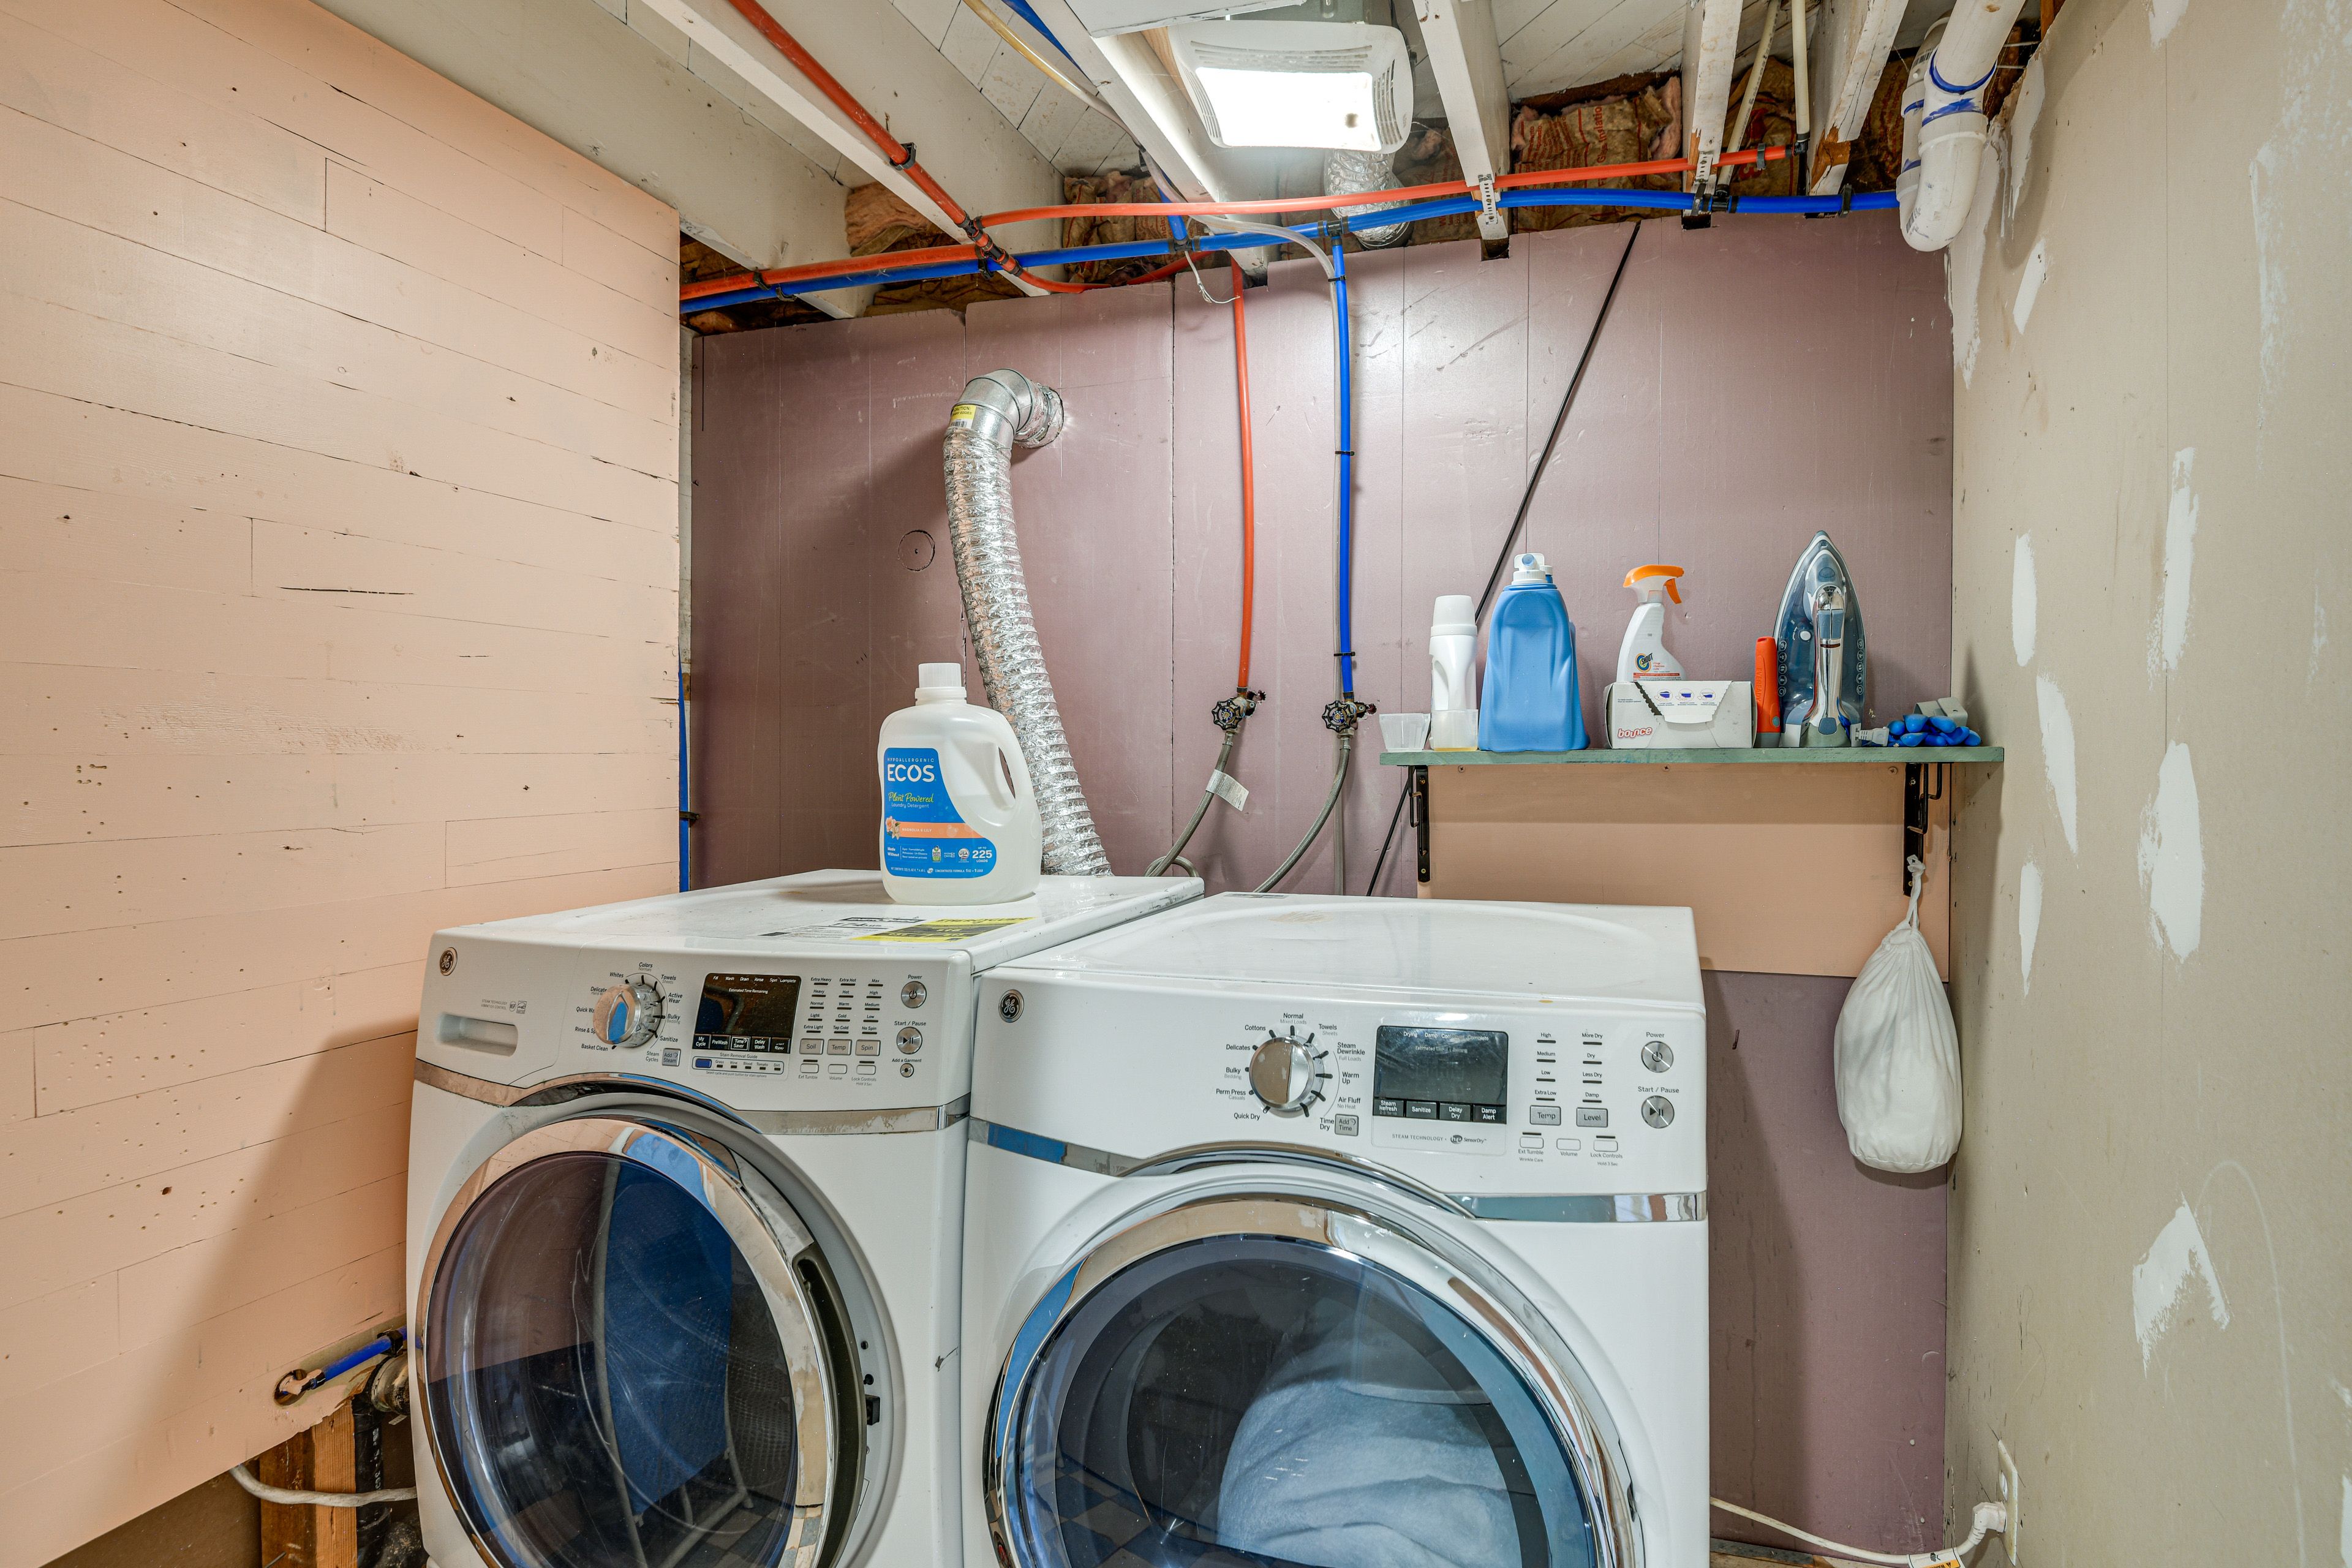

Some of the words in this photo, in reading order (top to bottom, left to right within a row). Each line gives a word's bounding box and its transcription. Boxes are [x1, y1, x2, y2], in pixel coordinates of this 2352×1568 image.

[1642, 653, 1653, 665] SHOUT
[1618, 727, 1653, 739] bounce
[888, 764, 935, 782] ECOS
[888, 791, 904, 802] Plant
[905, 793, 934, 803] Powered
[972, 850, 992, 859] 225
